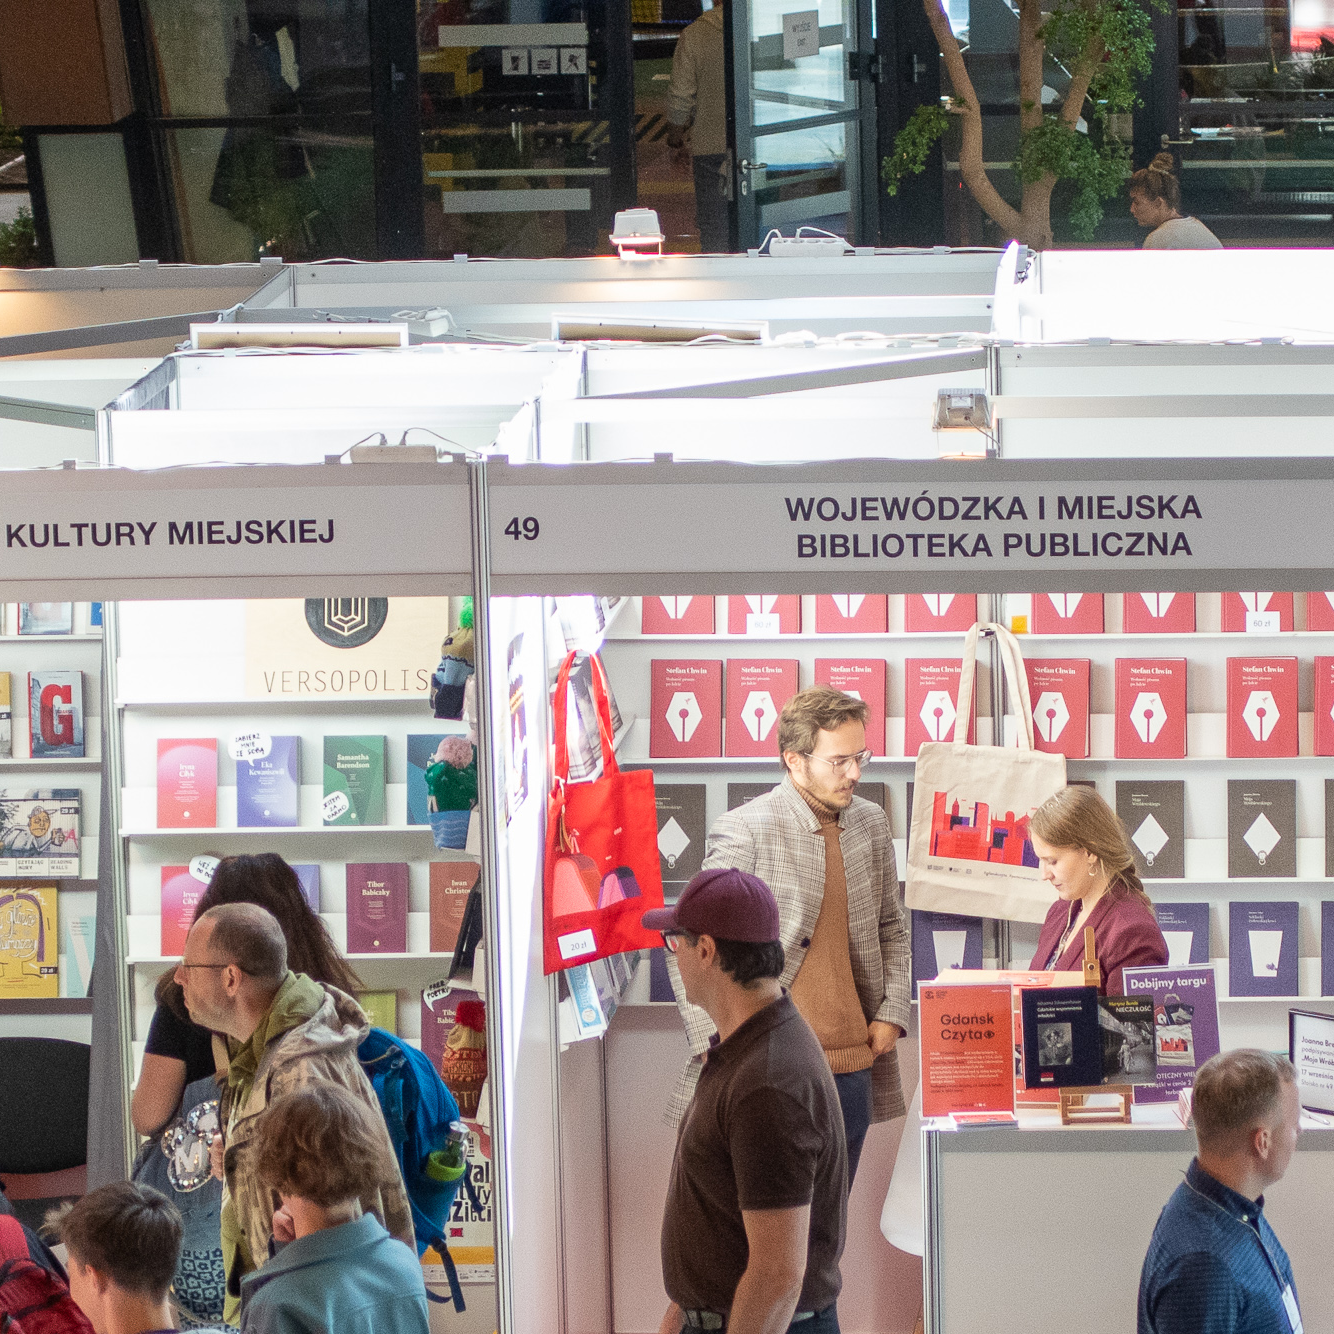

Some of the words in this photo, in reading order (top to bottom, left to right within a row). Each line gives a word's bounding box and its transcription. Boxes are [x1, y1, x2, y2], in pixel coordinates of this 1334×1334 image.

[785, 491, 1029, 523] WOJEWÓDZKA
[1039, 496, 1047, 522] I
[1058, 495, 1204, 521] MIEJSKA
[7, 522, 158, 549] KULTURY
[169, 519, 336, 546] MIEJSKIEJ
[505, 517, 541, 542] 49
[798, 534, 994, 560] BIBLIOTEKA
[1004, 532, 1194, 559] PUBLICZNA
[263, 669, 429, 693] VERSOPOLIS
[337, 753, 370, 762] Samantha
[260, 761, 273, 769] Eka
[336, 761, 370, 769] Barendson
[367, 880, 386, 888] Tibor
[1130, 978, 1175, 990] Dobijmy
[940, 1012, 995, 1026] Gdańsk
[940, 1028, 983, 1043] Czyta
[1301, 1036, 1324, 1047] Joanna
[1308, 1071, 1334, 1080] września
